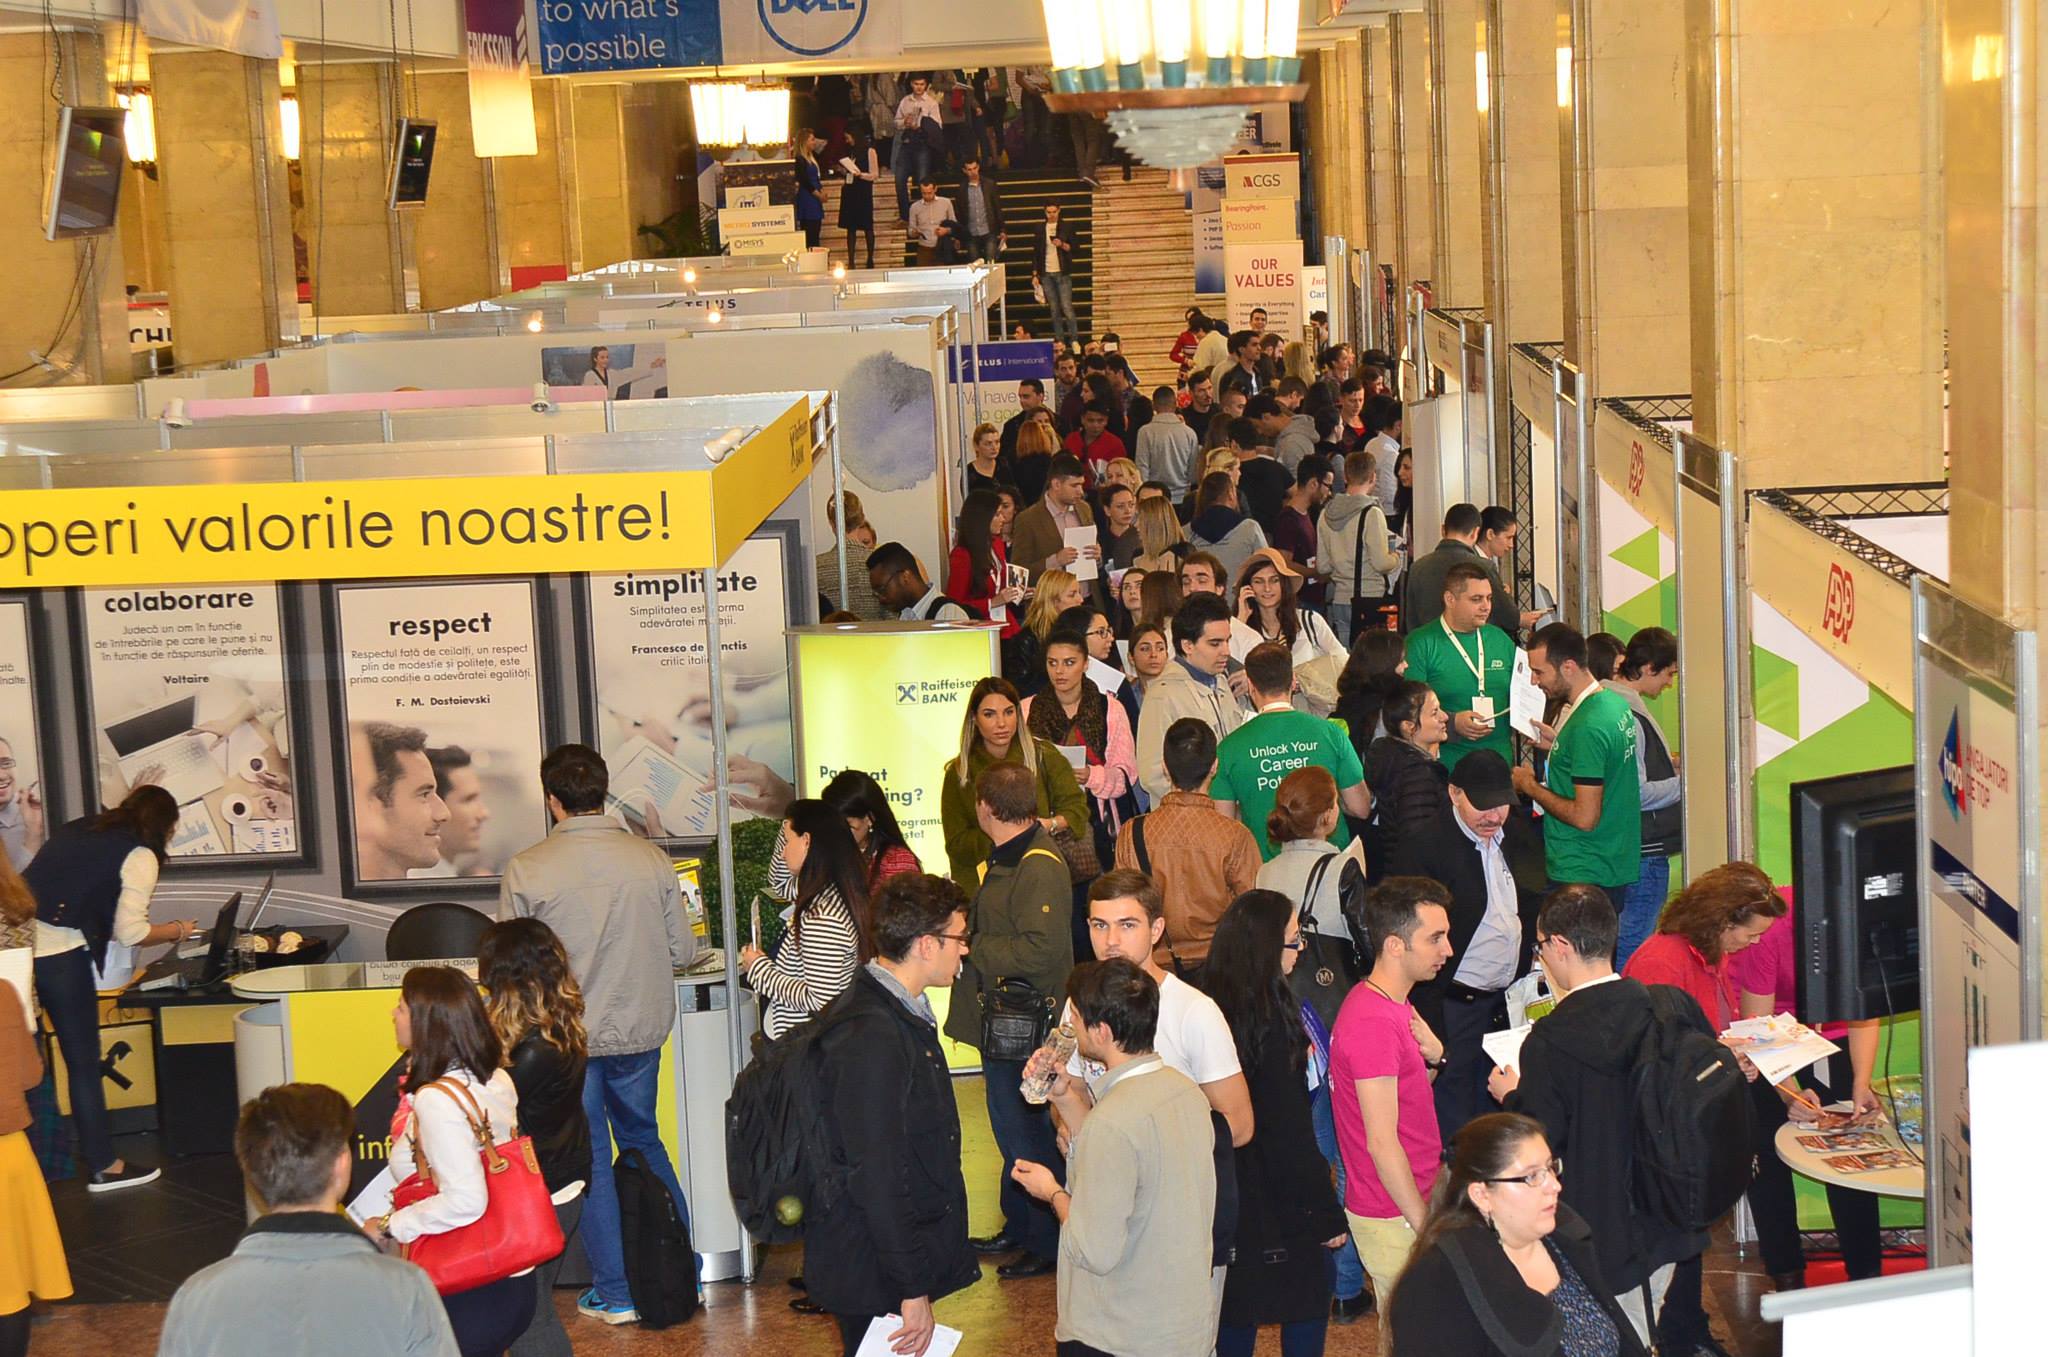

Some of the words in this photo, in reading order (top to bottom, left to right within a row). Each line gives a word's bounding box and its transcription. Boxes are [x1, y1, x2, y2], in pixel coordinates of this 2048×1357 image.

[543, 0, 573, 22] to
[546, 33, 666, 68] possible
[1253, 174, 1281, 188] CGS
[1225, 220, 1262, 231] Passion
[1251, 258, 1278, 270] OUR
[1234, 273, 1295, 288] VALUES
[984, 390, 1017, 404] have
[164, 495, 393, 553] valorile
[421, 490, 670, 547] noastre!
[104, 590, 254, 613] colaborare
[629, 605, 687, 618] Simplitatea
[161, 626, 175, 634] un
[177, 625, 194, 633] om
[388, 612, 492, 642] respect
[639, 616, 695, 629] adevăratei
[94, 640, 108, 649] de
[165, 638, 180, 649] pe
[182, 637, 207, 646] care
[220, 635, 246, 647] pune
[260, 634, 273, 643] nu
[351, 649, 398, 660] Respectul
[423, 647, 436, 656] de
[477, 647, 490, 655] un
[492, 644, 528, 656] respect
[631, 643, 687, 655] Francesco
[690, 643, 704, 652] de
[361, 662, 381, 674] plin
[382, 661, 395, 670] de
[398, 658, 443, 670] modestie
[500, 656, 521, 666] este
[660, 655, 685, 667] critic
[163, 673, 210, 684] Voltaire
[350, 675, 379, 687] prima
[423, 674, 431, 682] a
[395, 698, 405, 707] F.
[410, 697, 425, 706] M.
[430, 694, 491, 706] Dostoievski
[922, 692, 957, 704] BANK
[1249, 743, 1289, 759] Unlock
[1290, 741, 1319, 753] Your
[1260, 756, 1309, 773] Career
